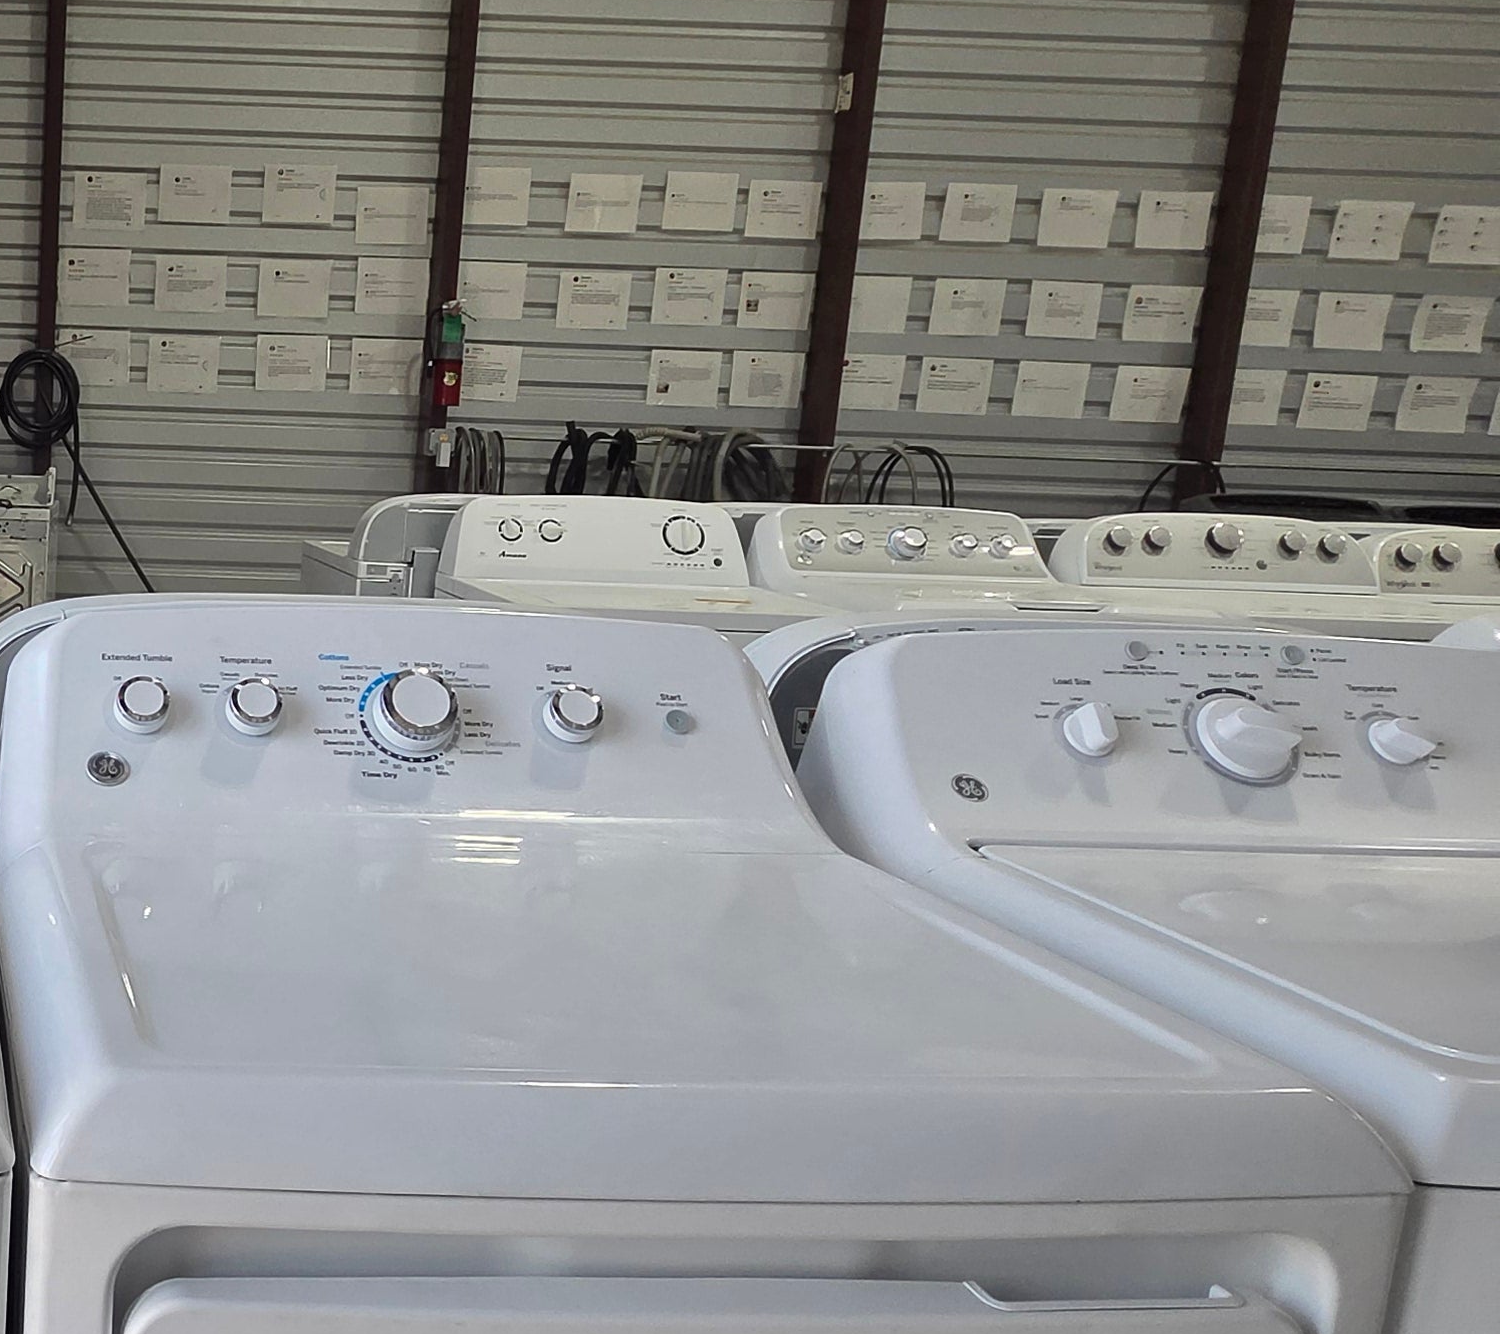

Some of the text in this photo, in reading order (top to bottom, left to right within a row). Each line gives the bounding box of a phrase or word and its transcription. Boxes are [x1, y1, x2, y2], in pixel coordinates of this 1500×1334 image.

[101, 653, 173, 662] Extended Tumble
[219, 656, 272, 665] Temperature
[546, 664, 572, 673] Signal
[348, 685, 361, 693] Dry
[1346, 684, 1397, 692] Temperature
[660, 693, 681, 701] Start
[383, 771, 398, 779] Dry
